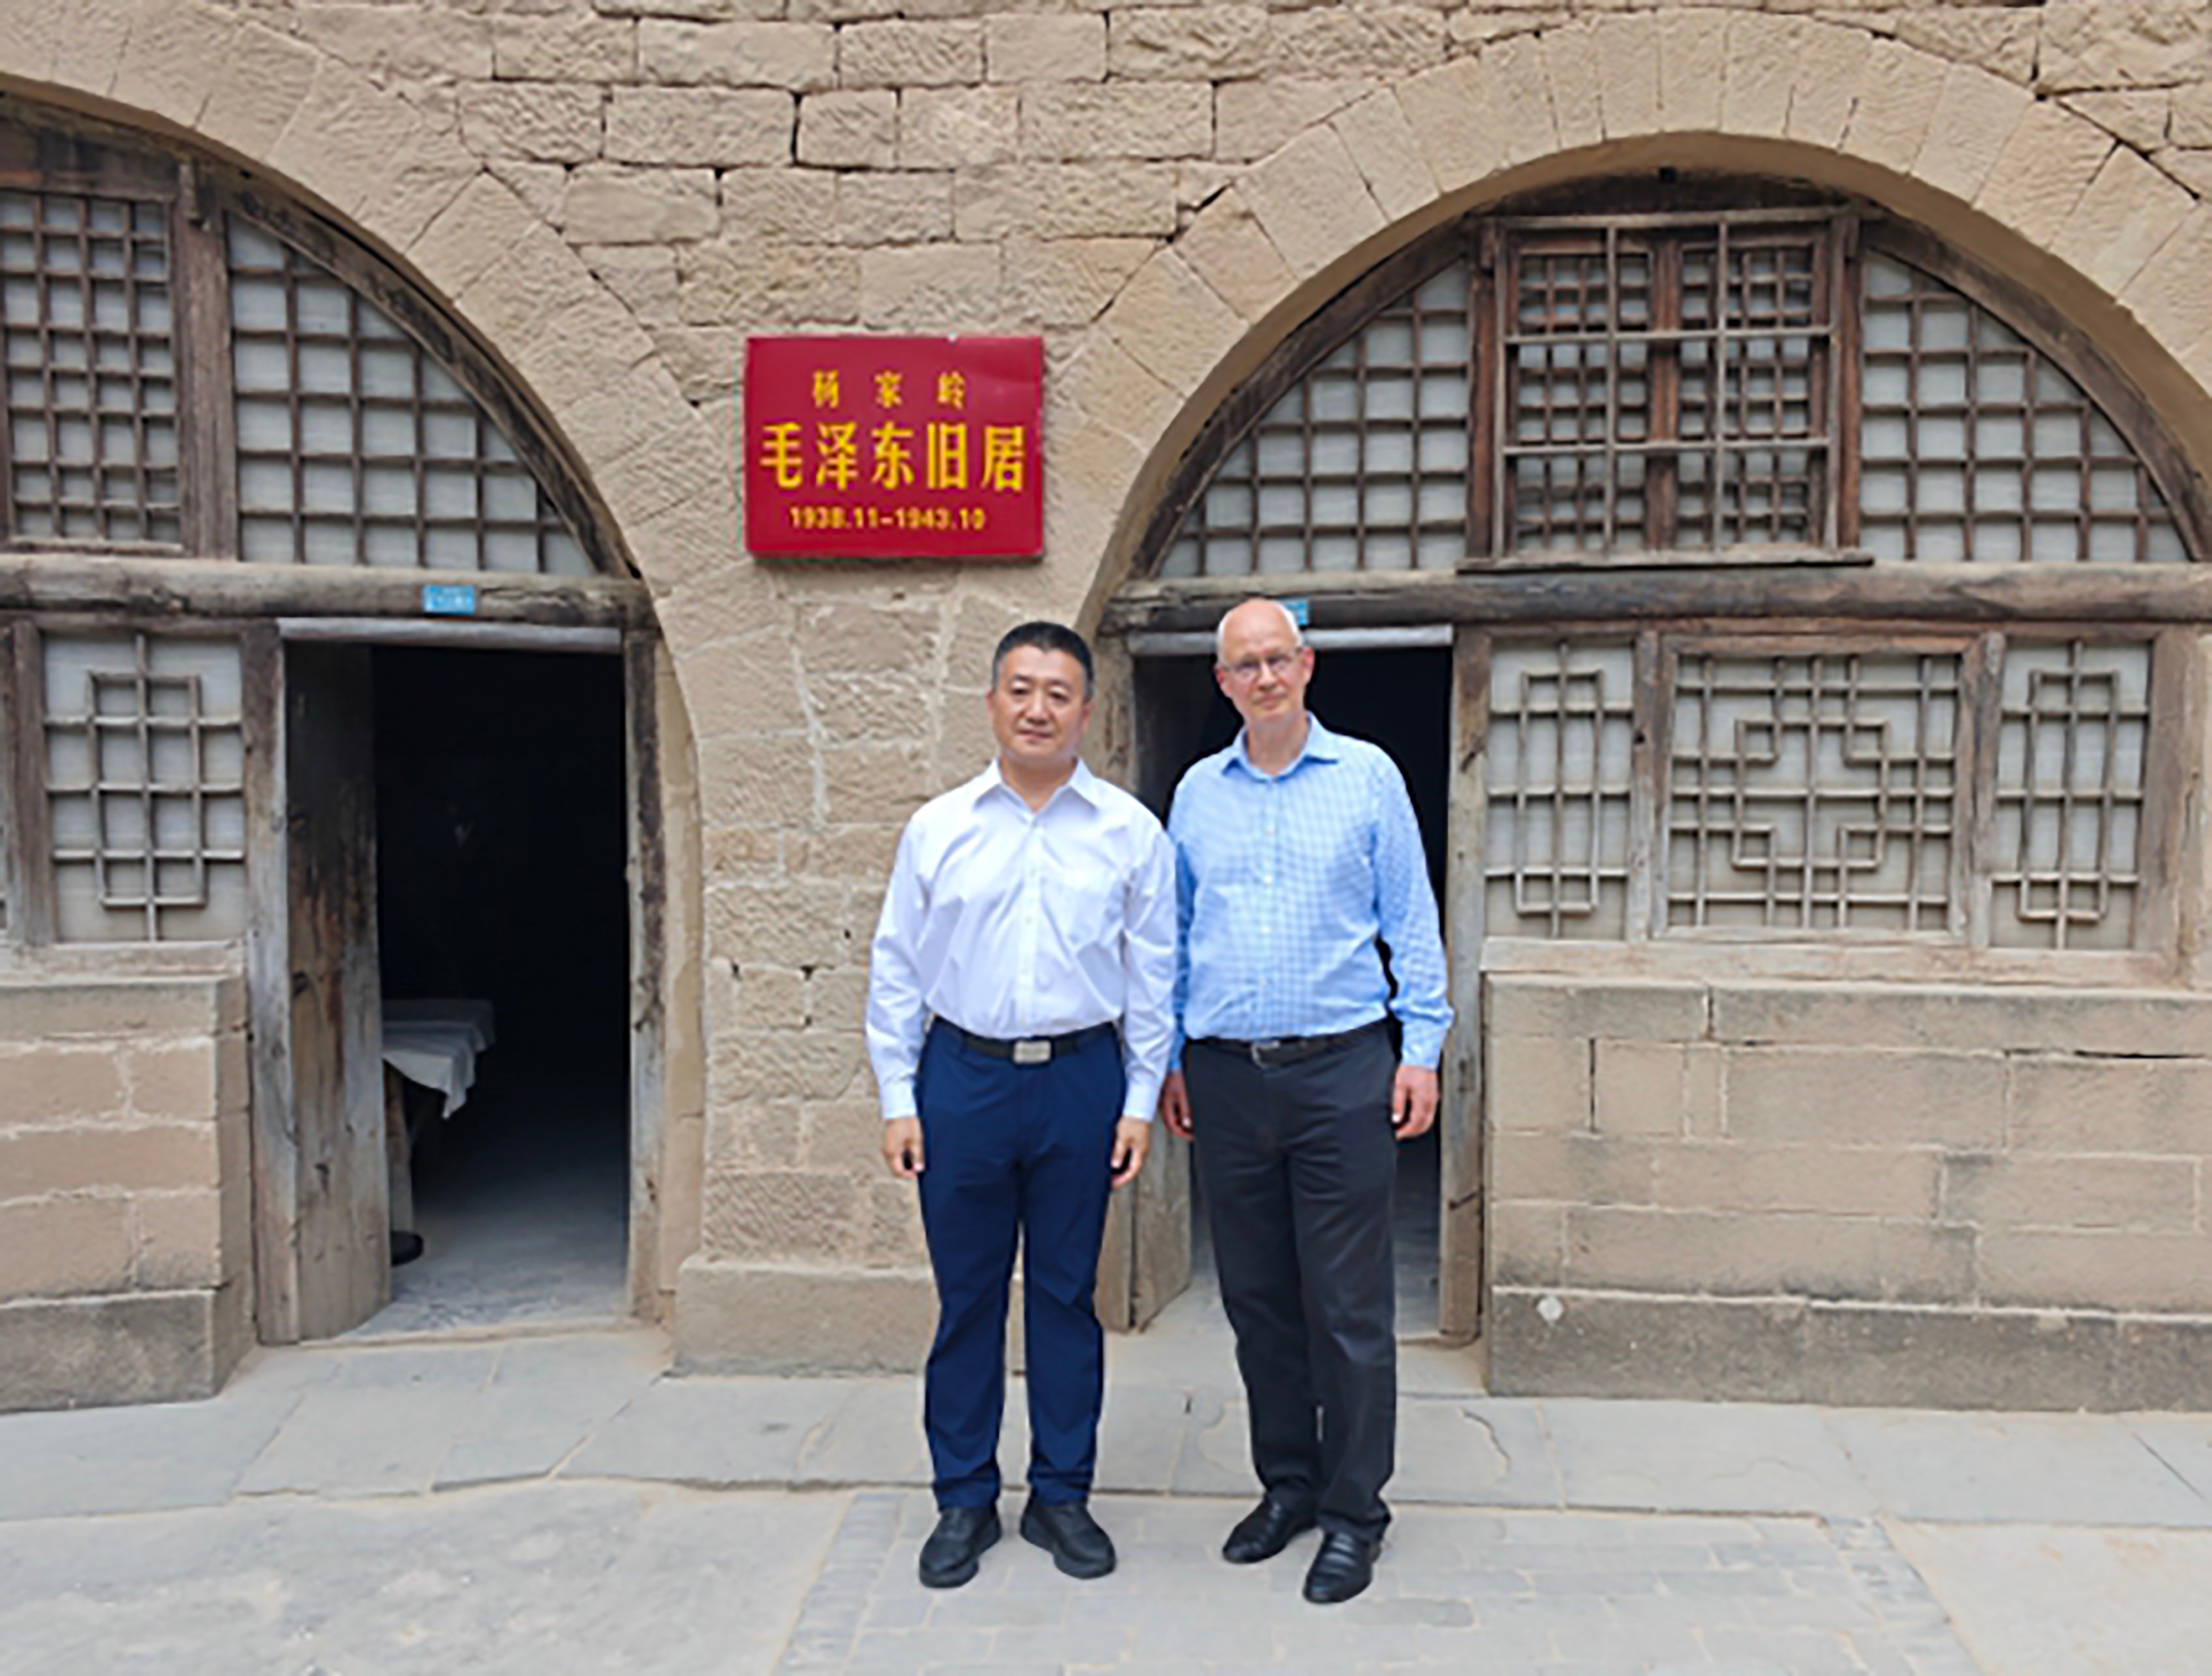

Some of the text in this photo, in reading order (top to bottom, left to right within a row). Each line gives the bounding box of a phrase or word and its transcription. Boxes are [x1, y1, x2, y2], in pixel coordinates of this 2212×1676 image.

[760, 420, 1026, 492] 毛泽东旧居
